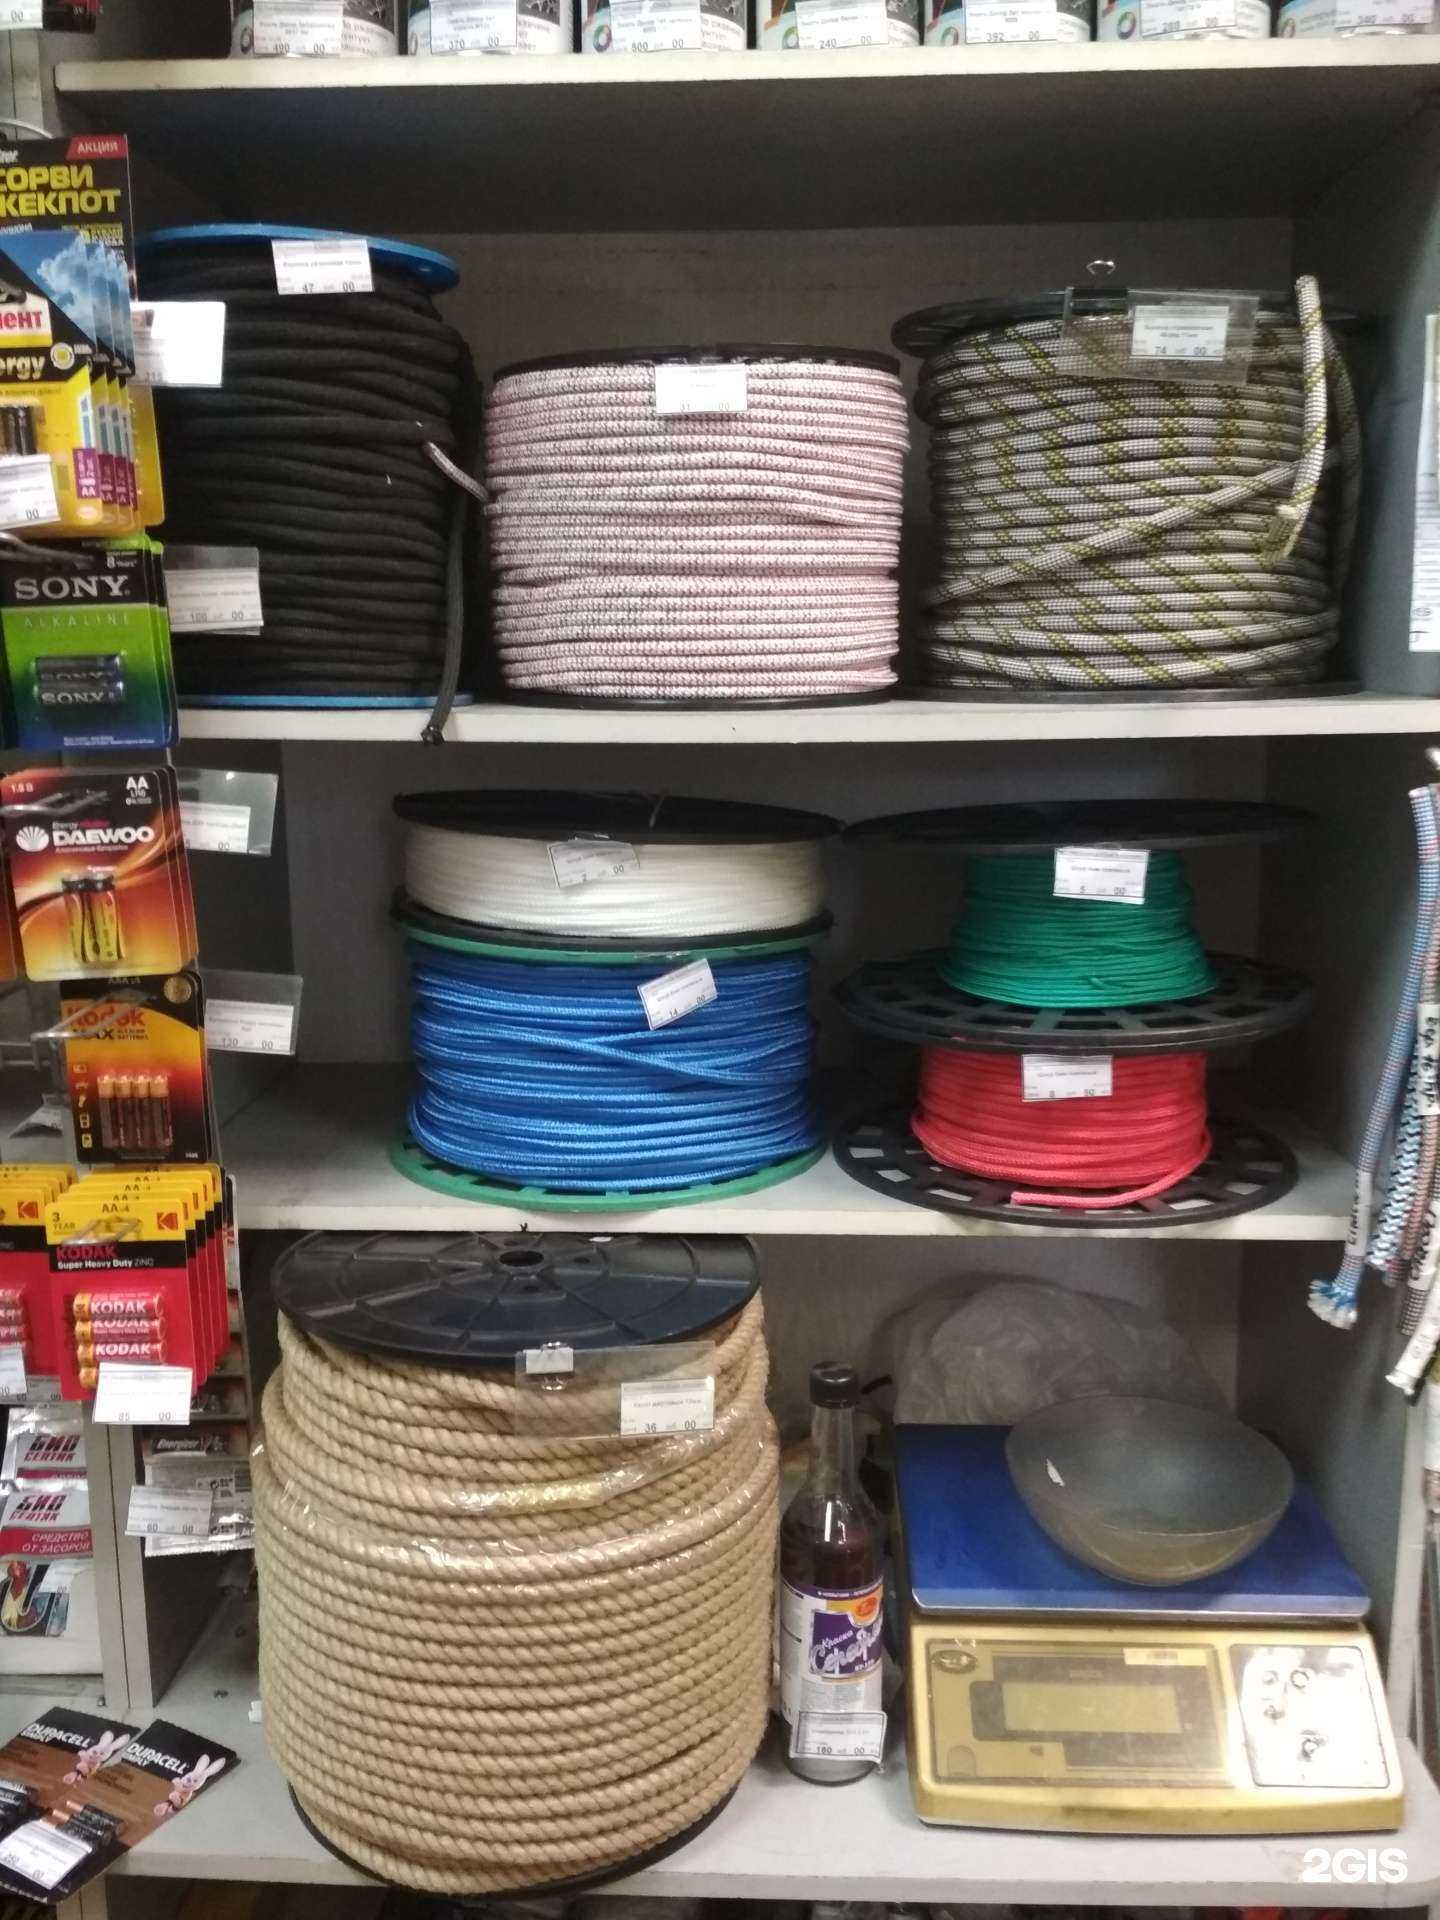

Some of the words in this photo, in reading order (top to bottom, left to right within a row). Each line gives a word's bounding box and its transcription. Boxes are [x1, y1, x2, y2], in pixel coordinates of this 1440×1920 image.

[77, 141, 118, 154] АКЦИЯ
[14, 575, 129, 601] SONY
[24, 613, 130, 627] ALKALINE
[41, 691, 104, 704] SONY
[126, 775, 148, 790] AA
[52, 825, 155, 846] DAEWOO
[102, 1203, 118, 1213] AA
[52, 1212, 61, 1222] 3
[57, 1260, 83, 1270] Super
[84, 1258, 111, 1269] Heavy
[112, 1257, 134, 1267] Duty
[90, 1300, 147, 1314] KODAK
[95, 1343, 151, 1356] KODAK
[30, 1434, 81, 1452] БИО
[16, 1494, 68, 1511] БИО
[31, 1531, 88, 1543] СРЕДСТВО
[22, 1544, 39, 1552] ОТ
[26, 1723, 92, 1749] DURACELL
[126, 1742, 188, 1775] DURACELL
